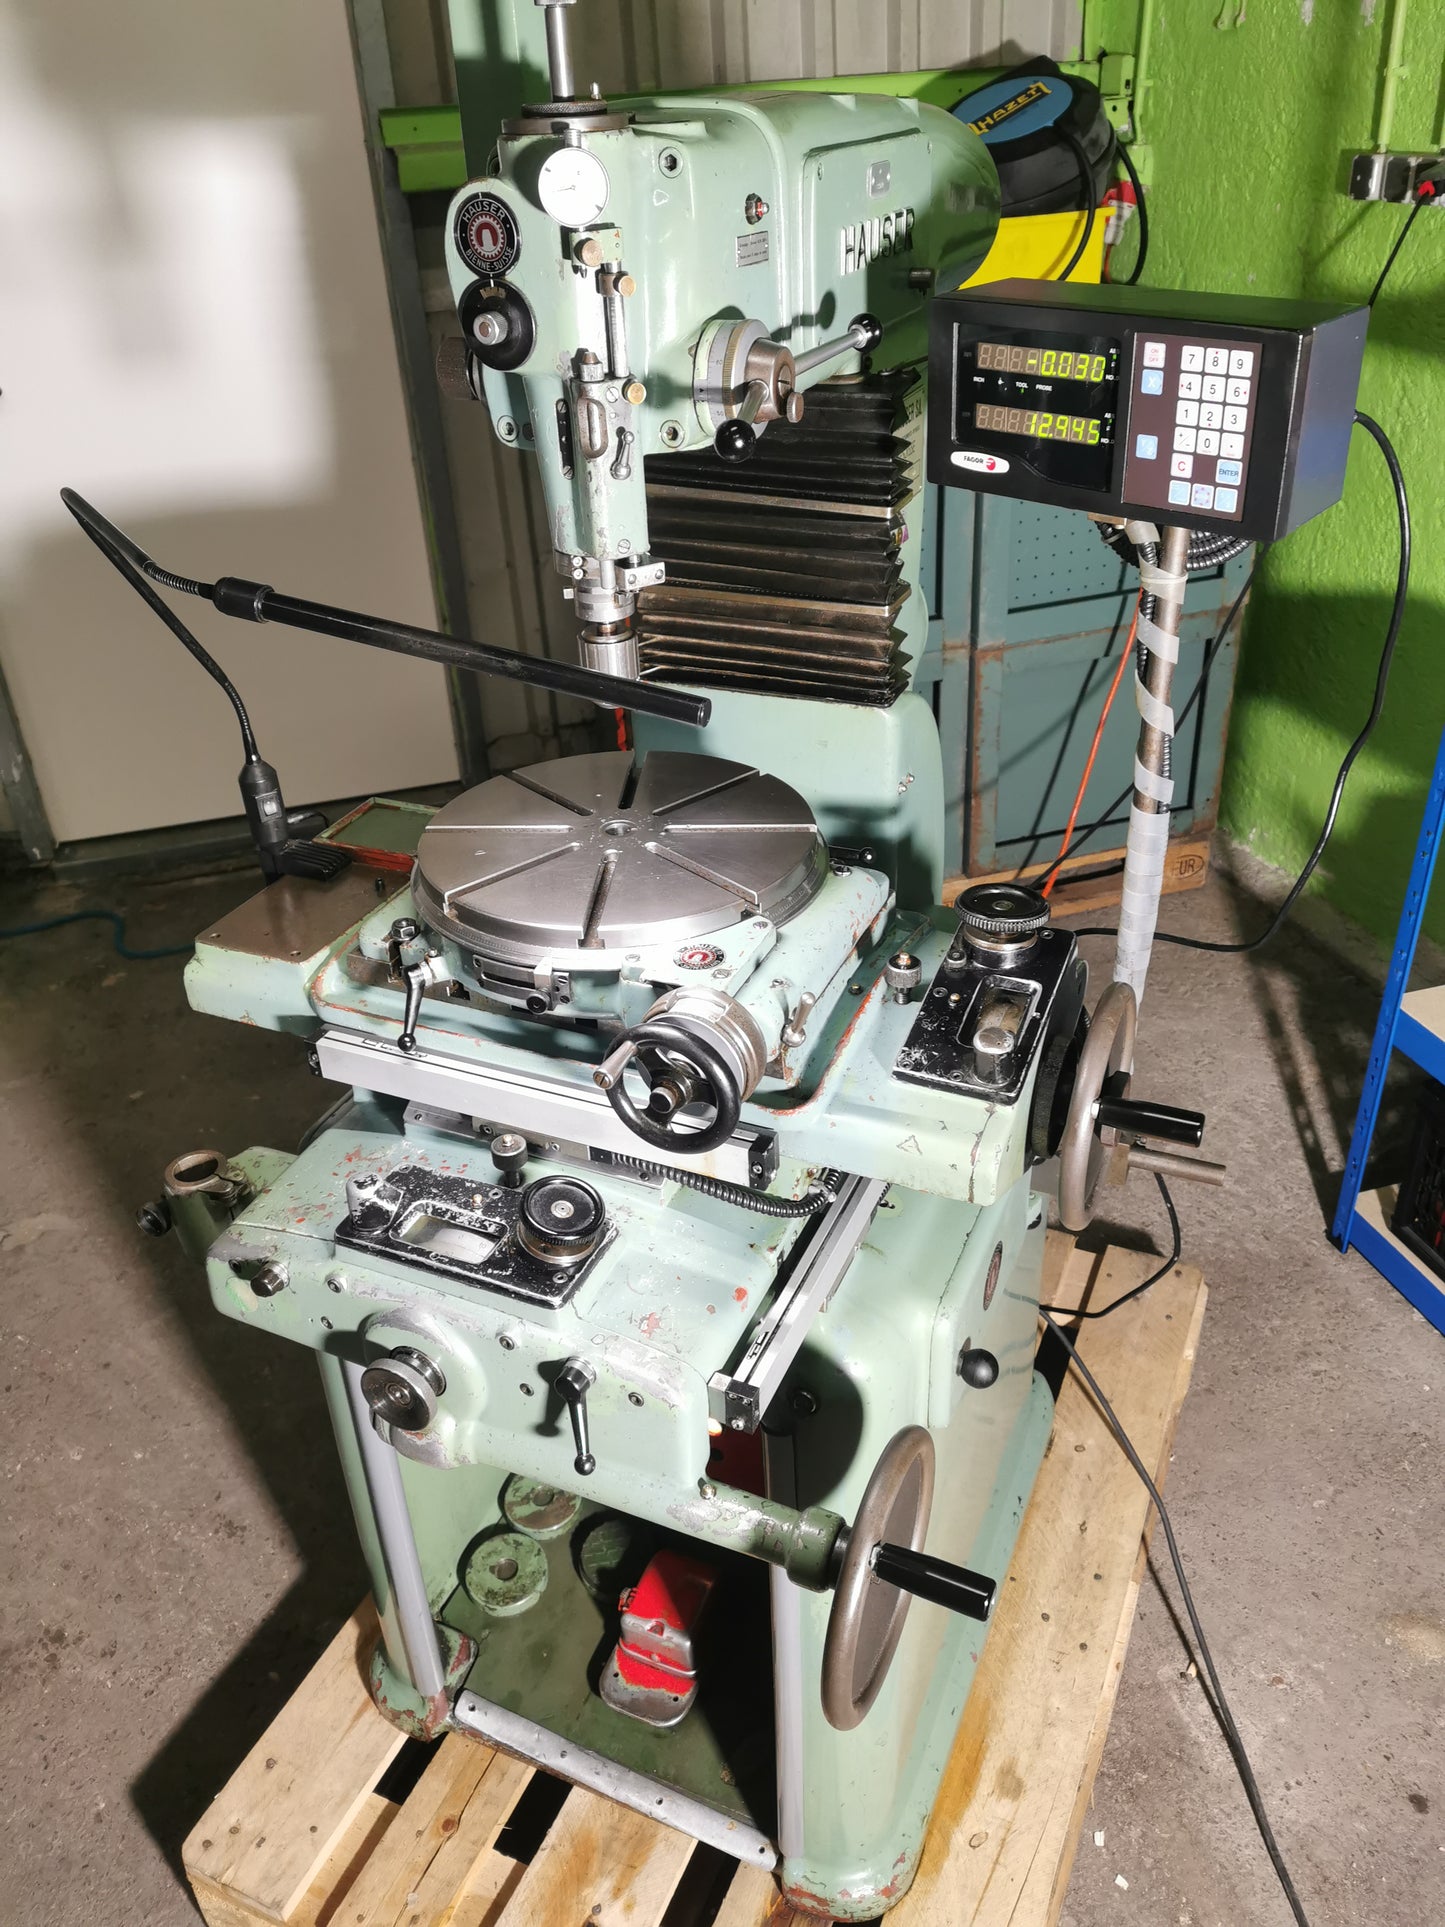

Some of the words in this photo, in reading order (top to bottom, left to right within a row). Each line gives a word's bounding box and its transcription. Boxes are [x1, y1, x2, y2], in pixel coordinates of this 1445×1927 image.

[977, 86, 1039, 130] HAZET
[462, 200, 506, 223] HAUSER
[840, 207, 915, 276] HAUSER
[465, 246, 513, 271] BIENNE-SUISSE
[1188, 354, 1195, 365] 7
[1212, 356, 1219, 367] 8
[1236, 358, 1244, 369] 9
[1147, 376, 1156, 388] X
[1185, 381, 1192, 392] 4
[1209, 384, 1216, 395] 5
[1233, 386, 1240, 397] 6
[1184, 408, 1189, 419] 1
[1206, 411, 1213, 422] 2
[1230, 414, 1237, 425] 3
[1204, 438, 1211, 449] 0
[963, 455, 984, 465] FAGOR
[1177, 460, 1186, 472] C
[1218, 468, 1239, 477] ENTER
